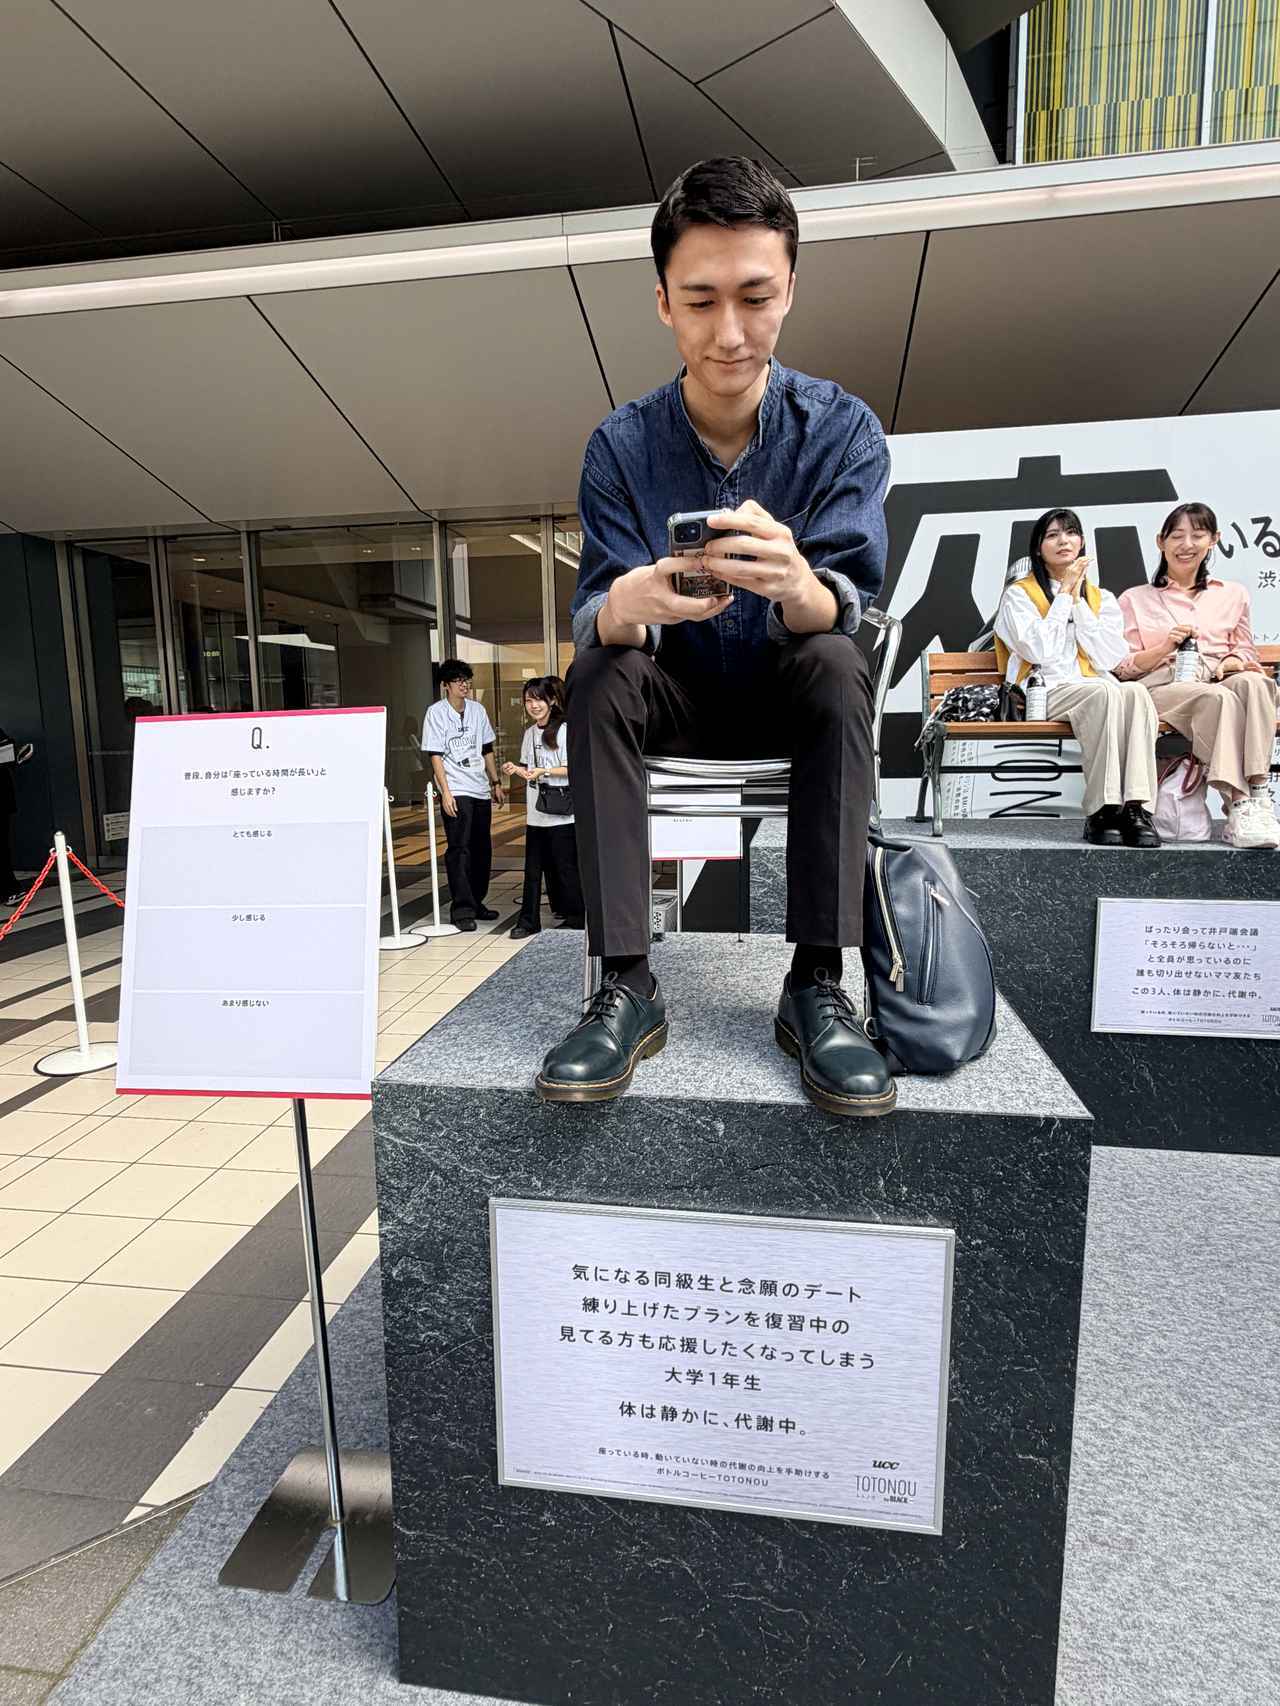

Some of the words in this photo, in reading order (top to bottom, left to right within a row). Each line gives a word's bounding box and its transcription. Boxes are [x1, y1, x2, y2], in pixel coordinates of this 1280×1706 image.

[1258, 570, 1280, 589] 渋
[251, 727, 270, 749] Q.
[232, 830, 273, 838] とても感じる
[232, 914, 266, 922] 少し感じる
[1147, 954, 1251, 965] と全員が思っているのに
[1136, 969, 1261, 980] 誰も切り出せないママ友たち
[222, 1000, 270, 1008] あまり感じない
[571, 1263, 862, 1303] 気になる同級生と念願のデート
[582, 1296, 850, 1335] 練り上げたプランを復習中の
[559, 1326, 875, 1370] 見てる方も応援したくなってしまう
[664, 1367, 763, 1392] 大学1年生
[618, 1401, 806, 1436] 体は静かに、代謝中。
[855, 1475, 917, 1497] TOTONOU
